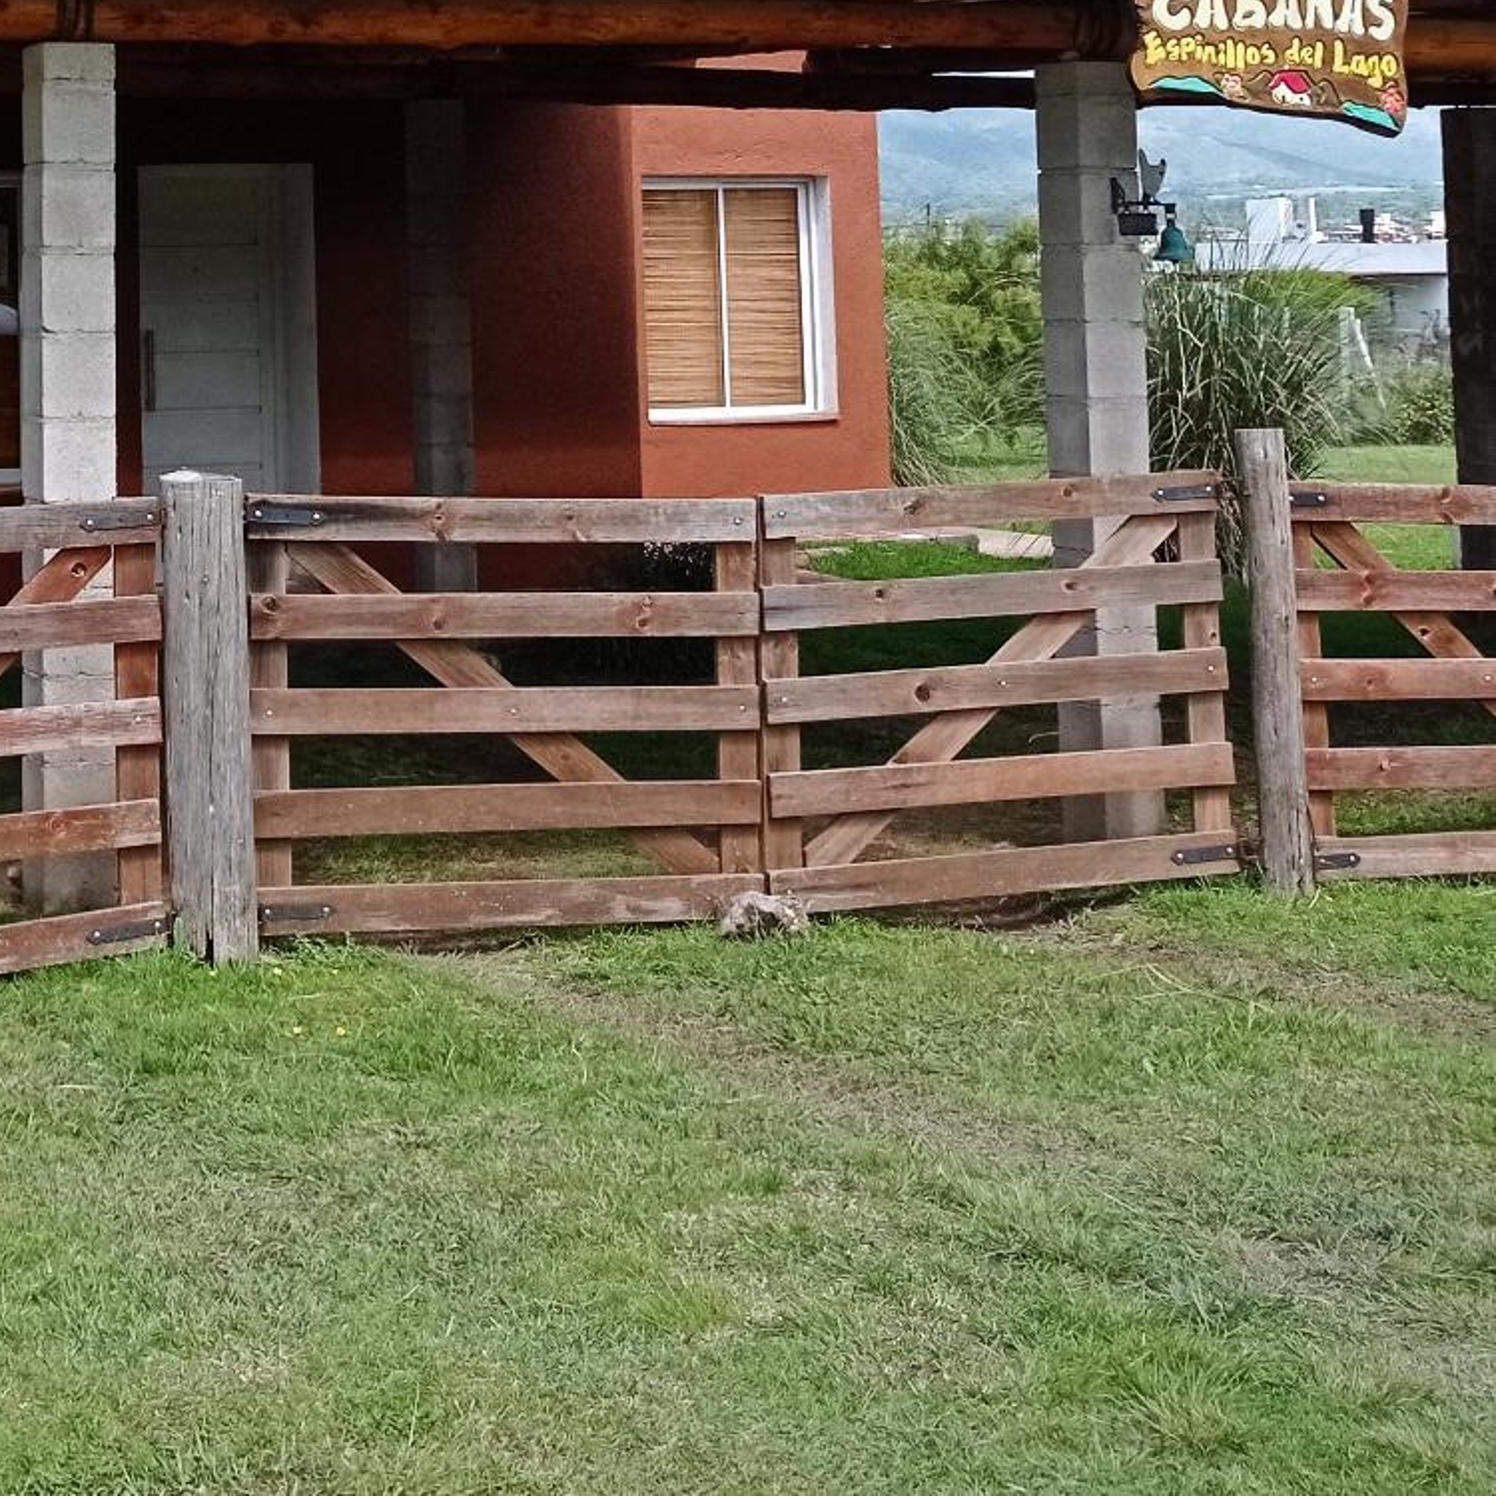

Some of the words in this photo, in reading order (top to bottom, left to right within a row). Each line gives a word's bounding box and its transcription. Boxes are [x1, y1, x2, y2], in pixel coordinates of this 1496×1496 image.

[1143, 30, 1275, 70] Espinillos
[1284, 36, 1324, 70] del
[1332, 39, 1398, 89] Lago
